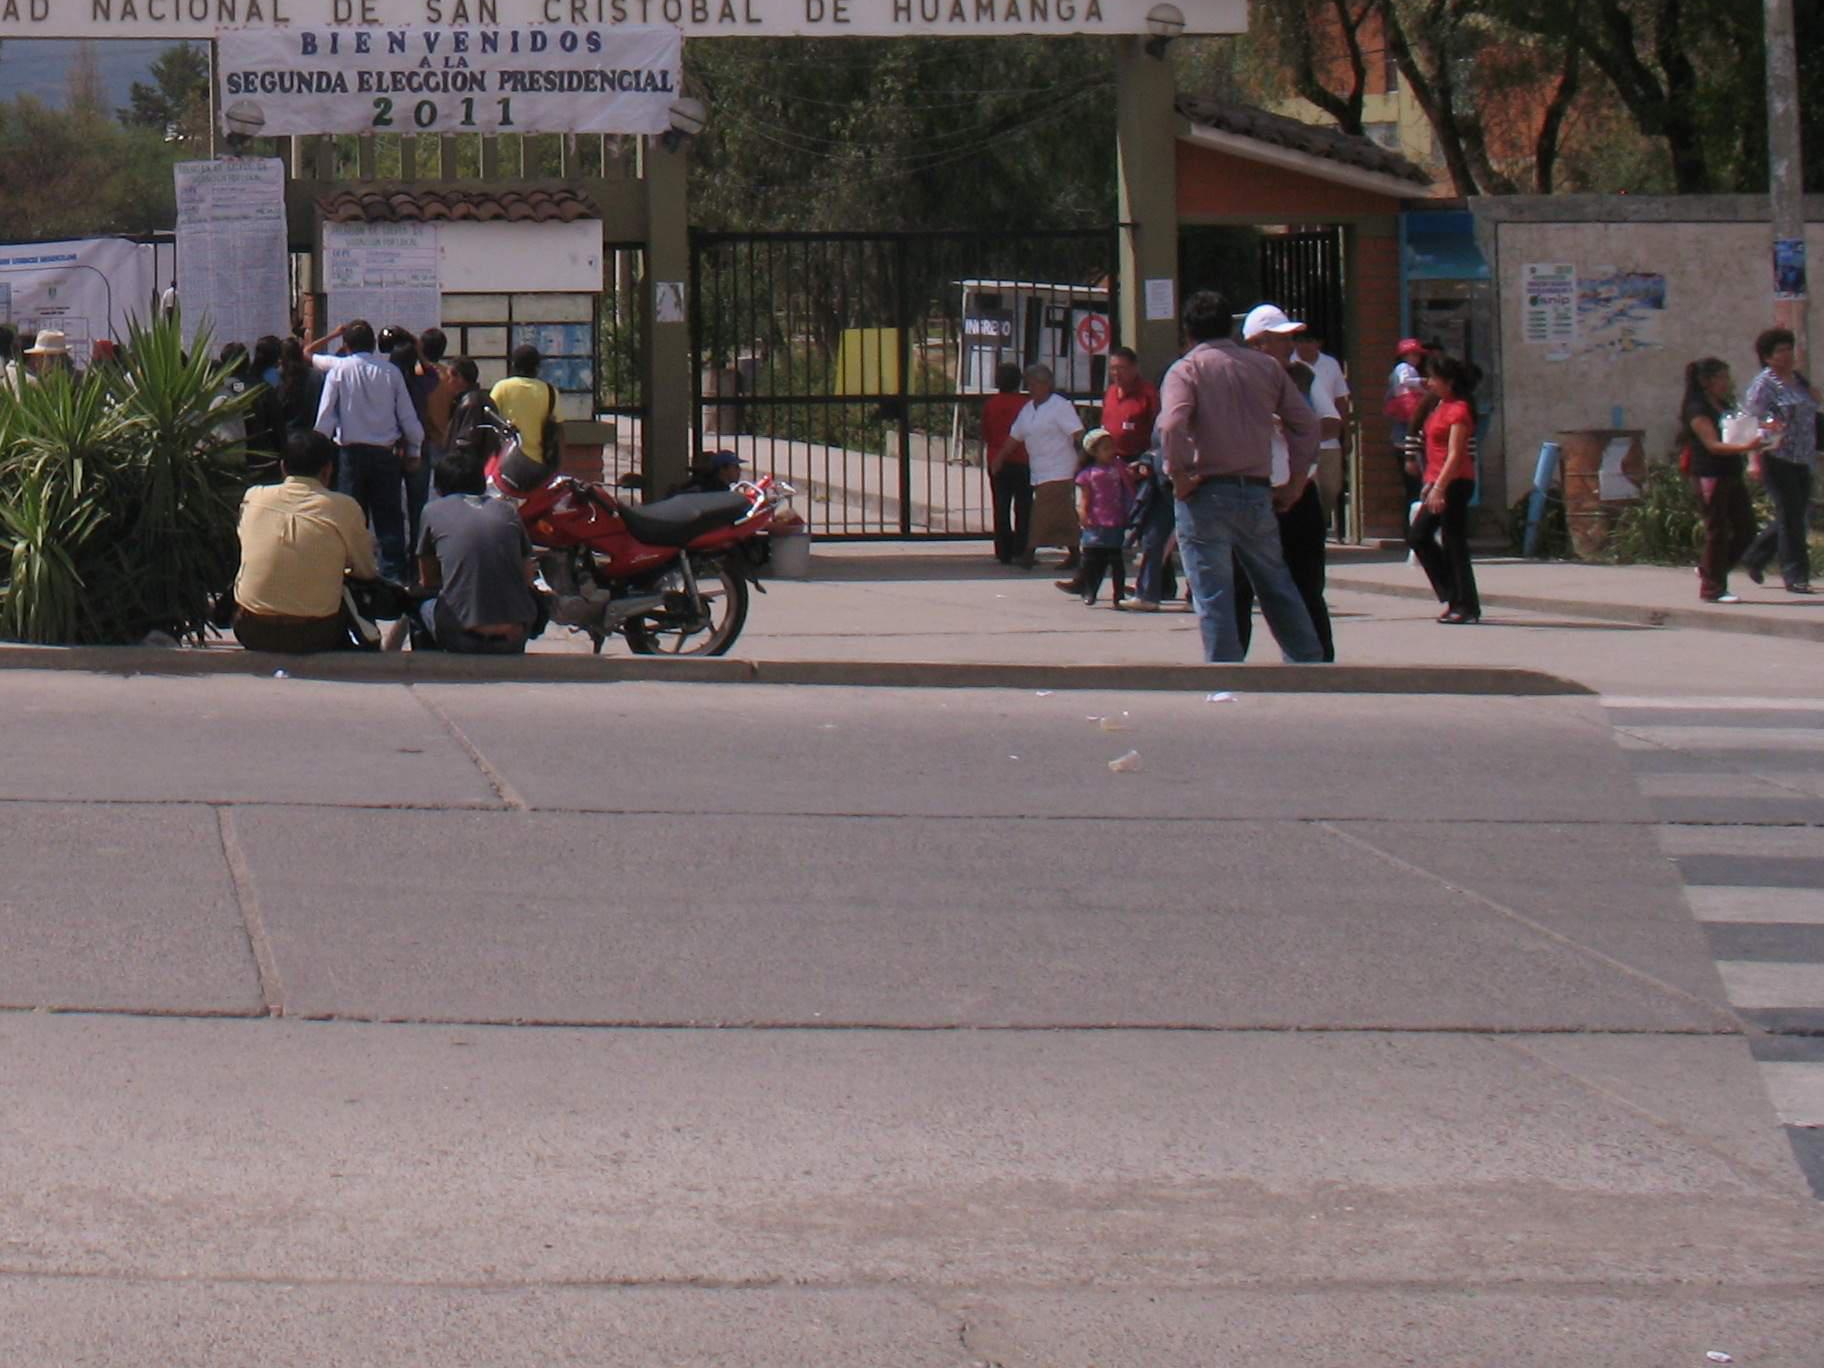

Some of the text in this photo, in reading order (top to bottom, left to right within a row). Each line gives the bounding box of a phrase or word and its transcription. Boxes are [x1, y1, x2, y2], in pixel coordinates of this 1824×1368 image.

[300, 30, 602, 56] BIENVENIDOS
[417, 55, 470, 69] A LA
[227, 70, 350, 95] SEGUNDA
[497, 69, 675, 94] PRESIDENCIAL
[372, 96, 515, 128] 2011
